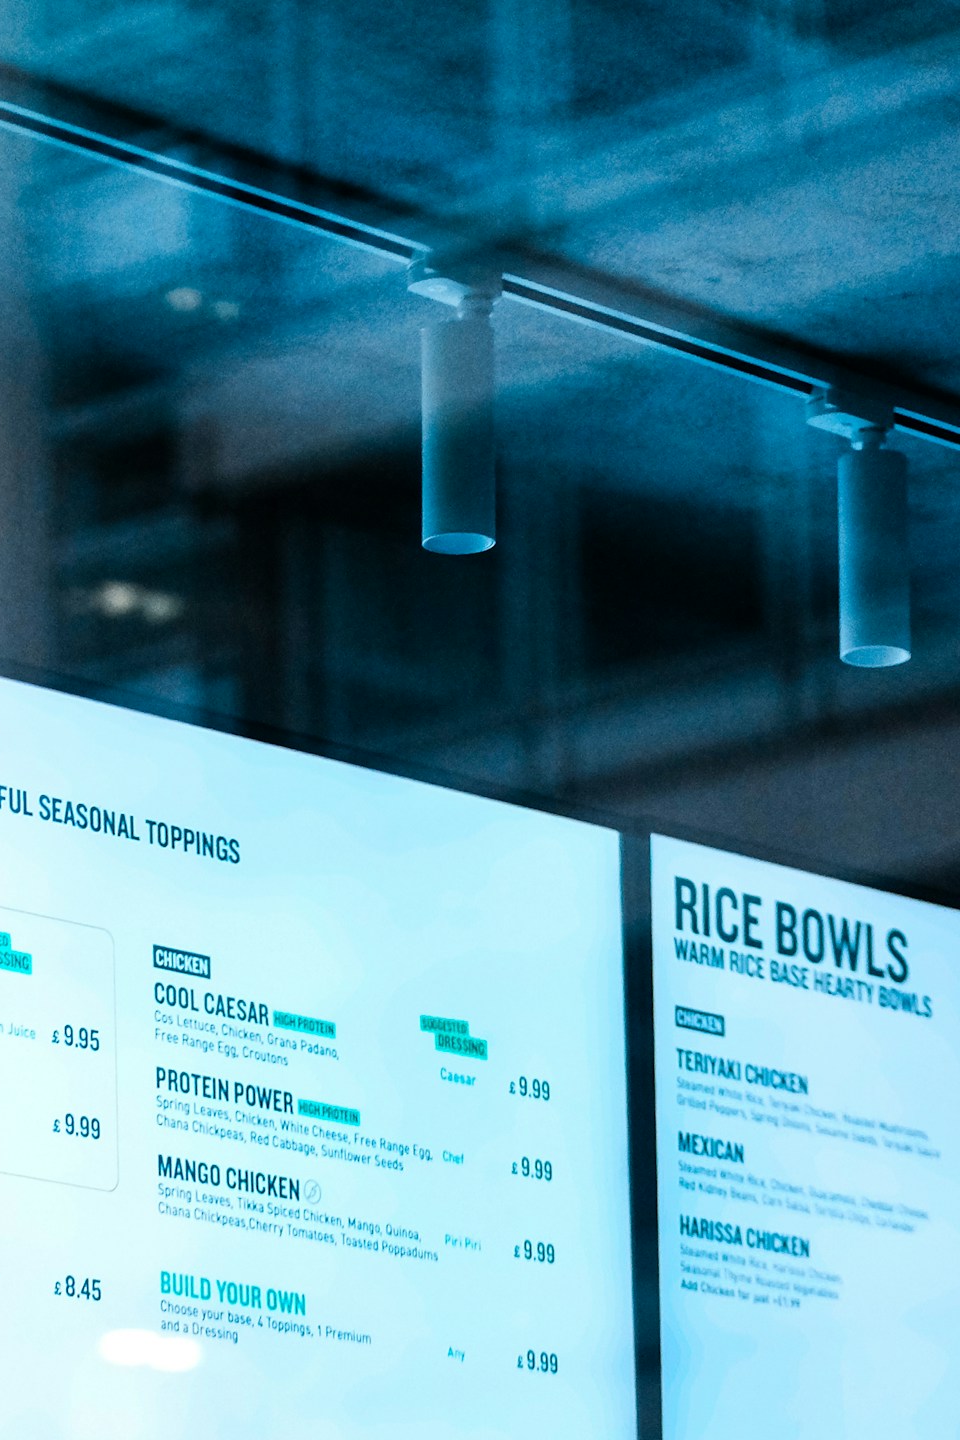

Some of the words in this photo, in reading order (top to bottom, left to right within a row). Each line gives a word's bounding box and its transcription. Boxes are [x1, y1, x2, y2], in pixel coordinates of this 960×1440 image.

[39, 795, 140, 842] SEASONAL
[146, 819, 241, 865] TOPPINGS
[675, 875, 763, 949] RICE
[776, 900, 909, 983] BOWLS
[156, 949, 208, 976] CHICKEN
[674, 937, 724, 969] WARM
[730, 950, 765, 978] RICE
[770, 960, 809, 989] BASE
[815, 970, 872, 1003] HEARTY
[879, 986, 933, 1018] BOWLS
[155, 983, 199, 1012] COOL
[204, 993, 269, 1026] CAESAR
[678, 1009, 722, 1033] CHICKEN
[8, 1020, 36, 1039] Juice
[155, 1010, 173, 1025] Cos
[177, 1015, 218, 1035] Lettuce,
[222, 1024, 263, 1044] Chicken,
[268, 1033, 297, 1050] Grana
[157, 1067, 228, 1102] PROTEIN
[235, 1082, 293, 1114] POWER
[440, 1067, 476, 1086] Caesar
[676, 1048, 740, 1081] TERIYAKI
[746, 1065, 808, 1094] CHICKEN
[157, 1095, 190, 1116] Spring
[194, 1102, 232, 1122] Leaves,
[236, 1110, 277, 1131] Chicken,
[280, 1119, 309, 1137] White
[355, 1133, 376, 1148] Free
[380, 1138, 410, 1156] Range
[157, 1114, 189, 1131] Chana
[192, 1121, 246, 1143] Chickpeas,
[250, 1131, 269, 1145] Red
[321, 1144, 371, 1166] Sunflower
[375, 1154, 404, 1171] Seeds
[678, 1131, 744, 1164] MEXICAN
[158, 1154, 220, 1186] MANGO
[227, 1167, 300, 1201] CHICKEN
[158, 1183, 192, 1203] Spring
[195, 1190, 234, 1210] Leaves,
[238, 1197, 264, 1214] Tikka
[268, 1203, 300, 1221] Spiced
[303, 1209, 345, 1229] Chicken,
[348, 1217, 383, 1236] Mango,
[386, 1224, 422, 1243] Quinoa,
[158, 1202, 191, 1219] Chana
[287, 1223, 337, 1246] Tomatoes,
[341, 1233, 379, 1251] Toasted
[382, 1241, 438, 1262] Poppadums
[680, 1214, 742, 1246] HARISSA
[747, 1228, 809, 1258] CHICKEN
[161, 1271, 211, 1301] BUILD
[216, 1280, 261, 1309] YOUR
[267, 1288, 306, 1316] OWN
[161, 1300, 198, 1317] Choose
[202, 1308, 223, 1321] your
[228, 1312, 254, 1328] base,
[267, 1317, 314, 1337] Toppings,
[326, 1326, 371, 1344] Premium
[161, 1319, 179, 1332] and
[193, 1323, 238, 1344] Dressing
